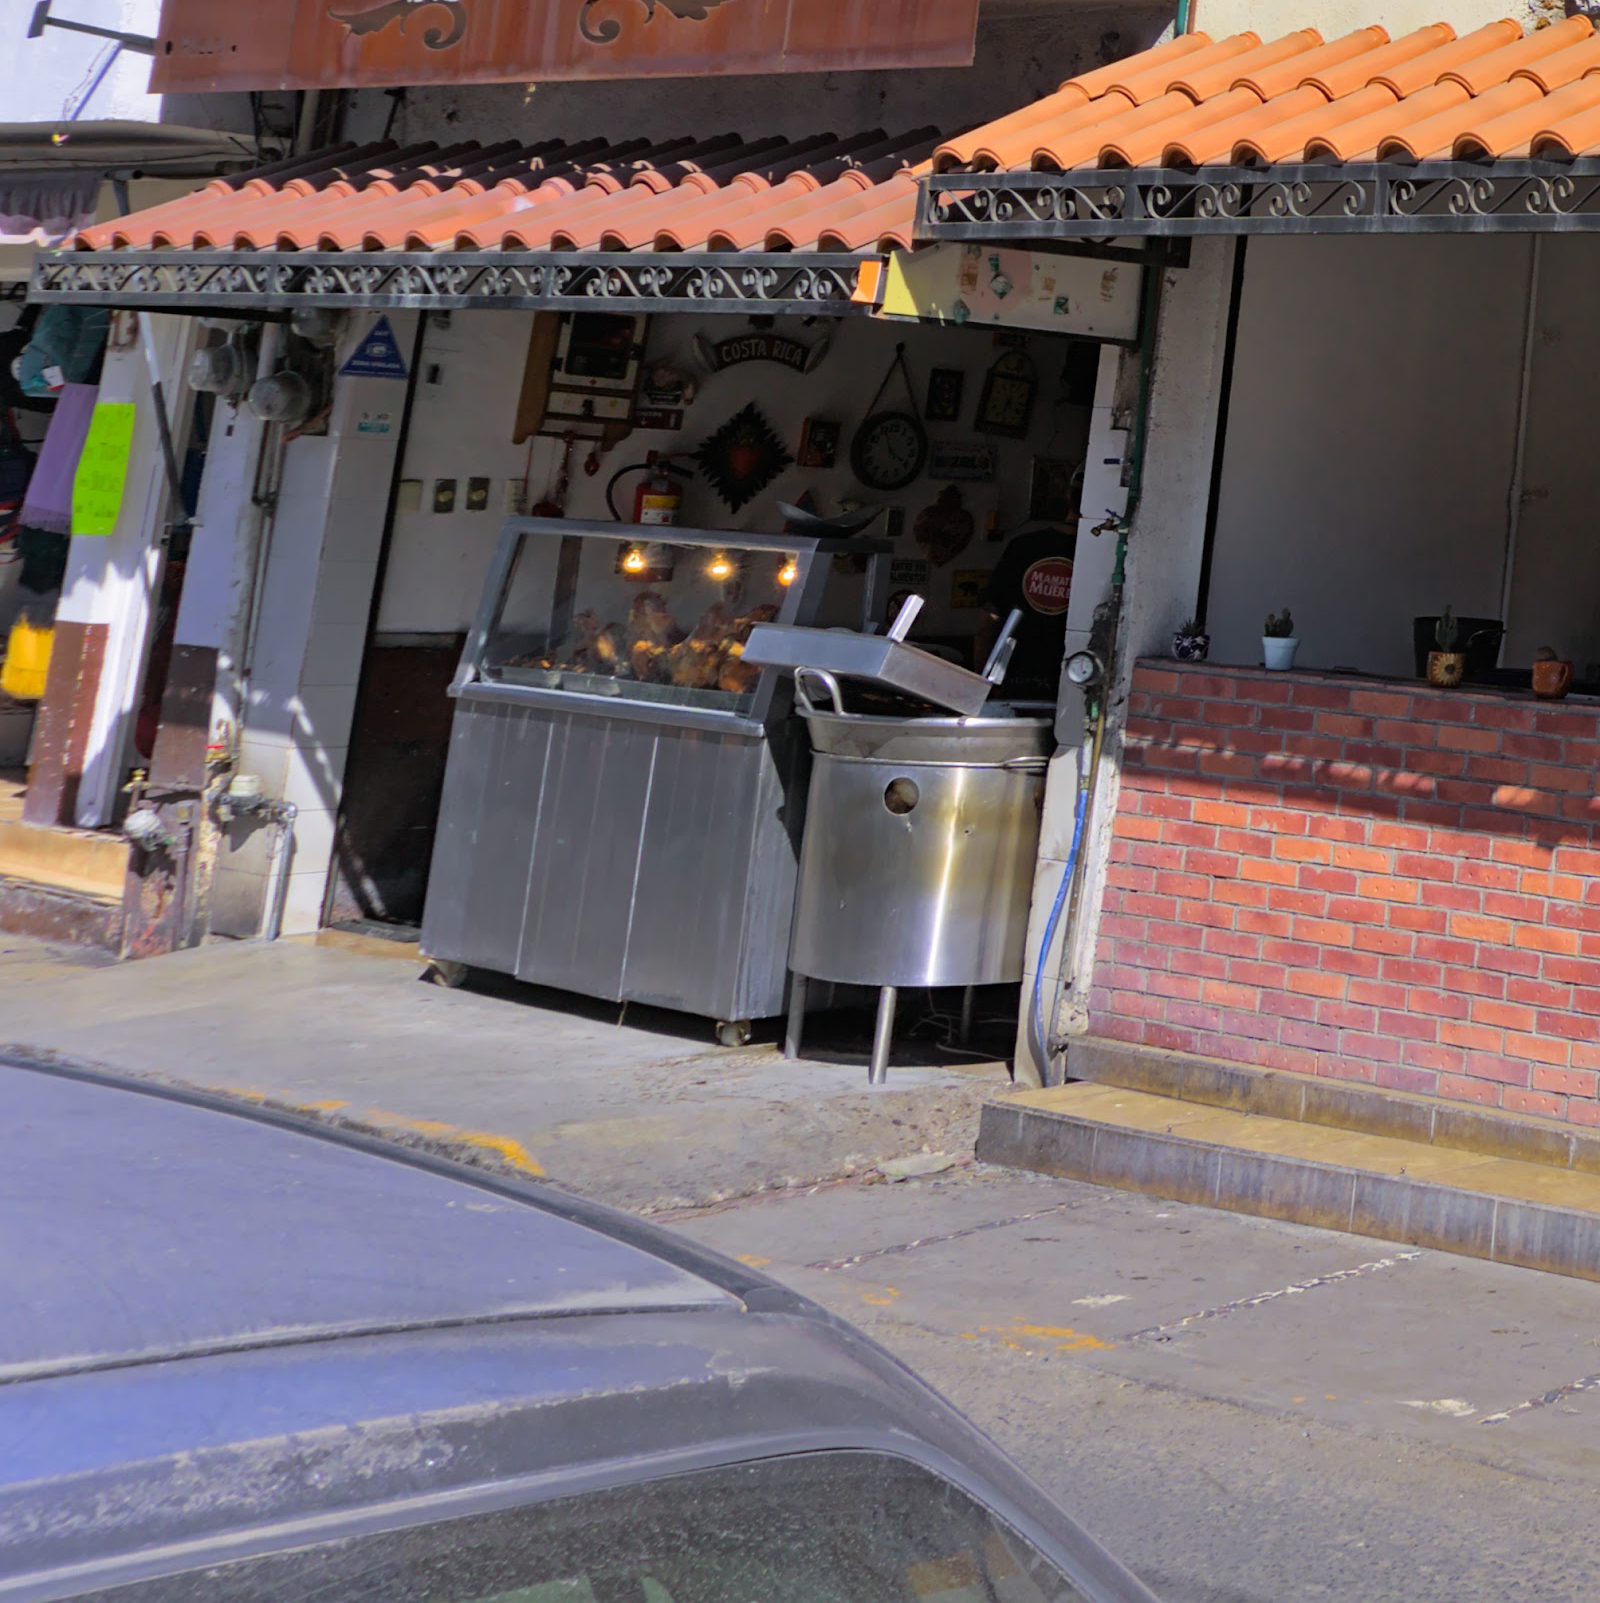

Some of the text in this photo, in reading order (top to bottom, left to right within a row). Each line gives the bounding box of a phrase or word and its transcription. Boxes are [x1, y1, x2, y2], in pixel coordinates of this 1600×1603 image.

[721, 338, 803, 366] COSTA RICA
[1031, 570, 1072, 587] MAMAT
